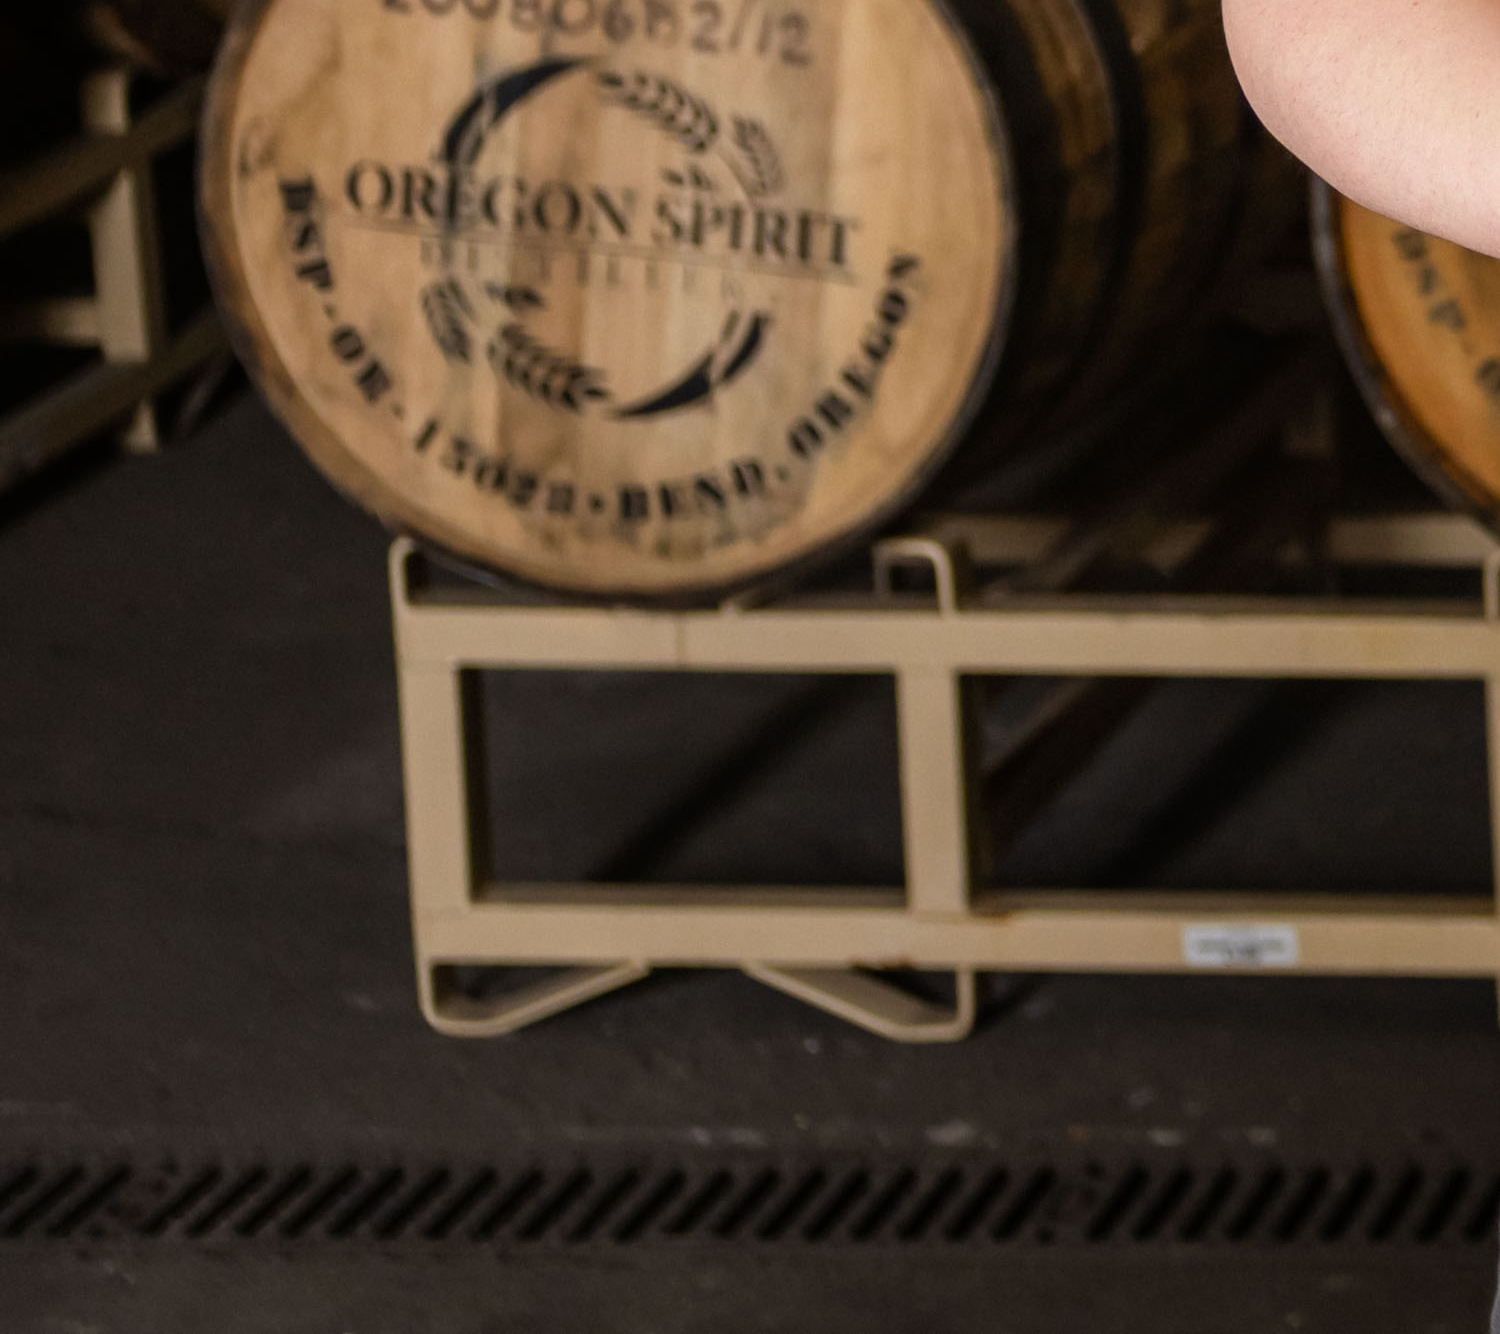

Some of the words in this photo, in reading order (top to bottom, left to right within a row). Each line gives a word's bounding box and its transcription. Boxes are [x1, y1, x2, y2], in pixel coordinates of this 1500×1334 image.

[344, 158, 636, 246] OREGON
[652, 185, 863, 272] SPIRIT
[787, 248, 924, 462] OREGON
